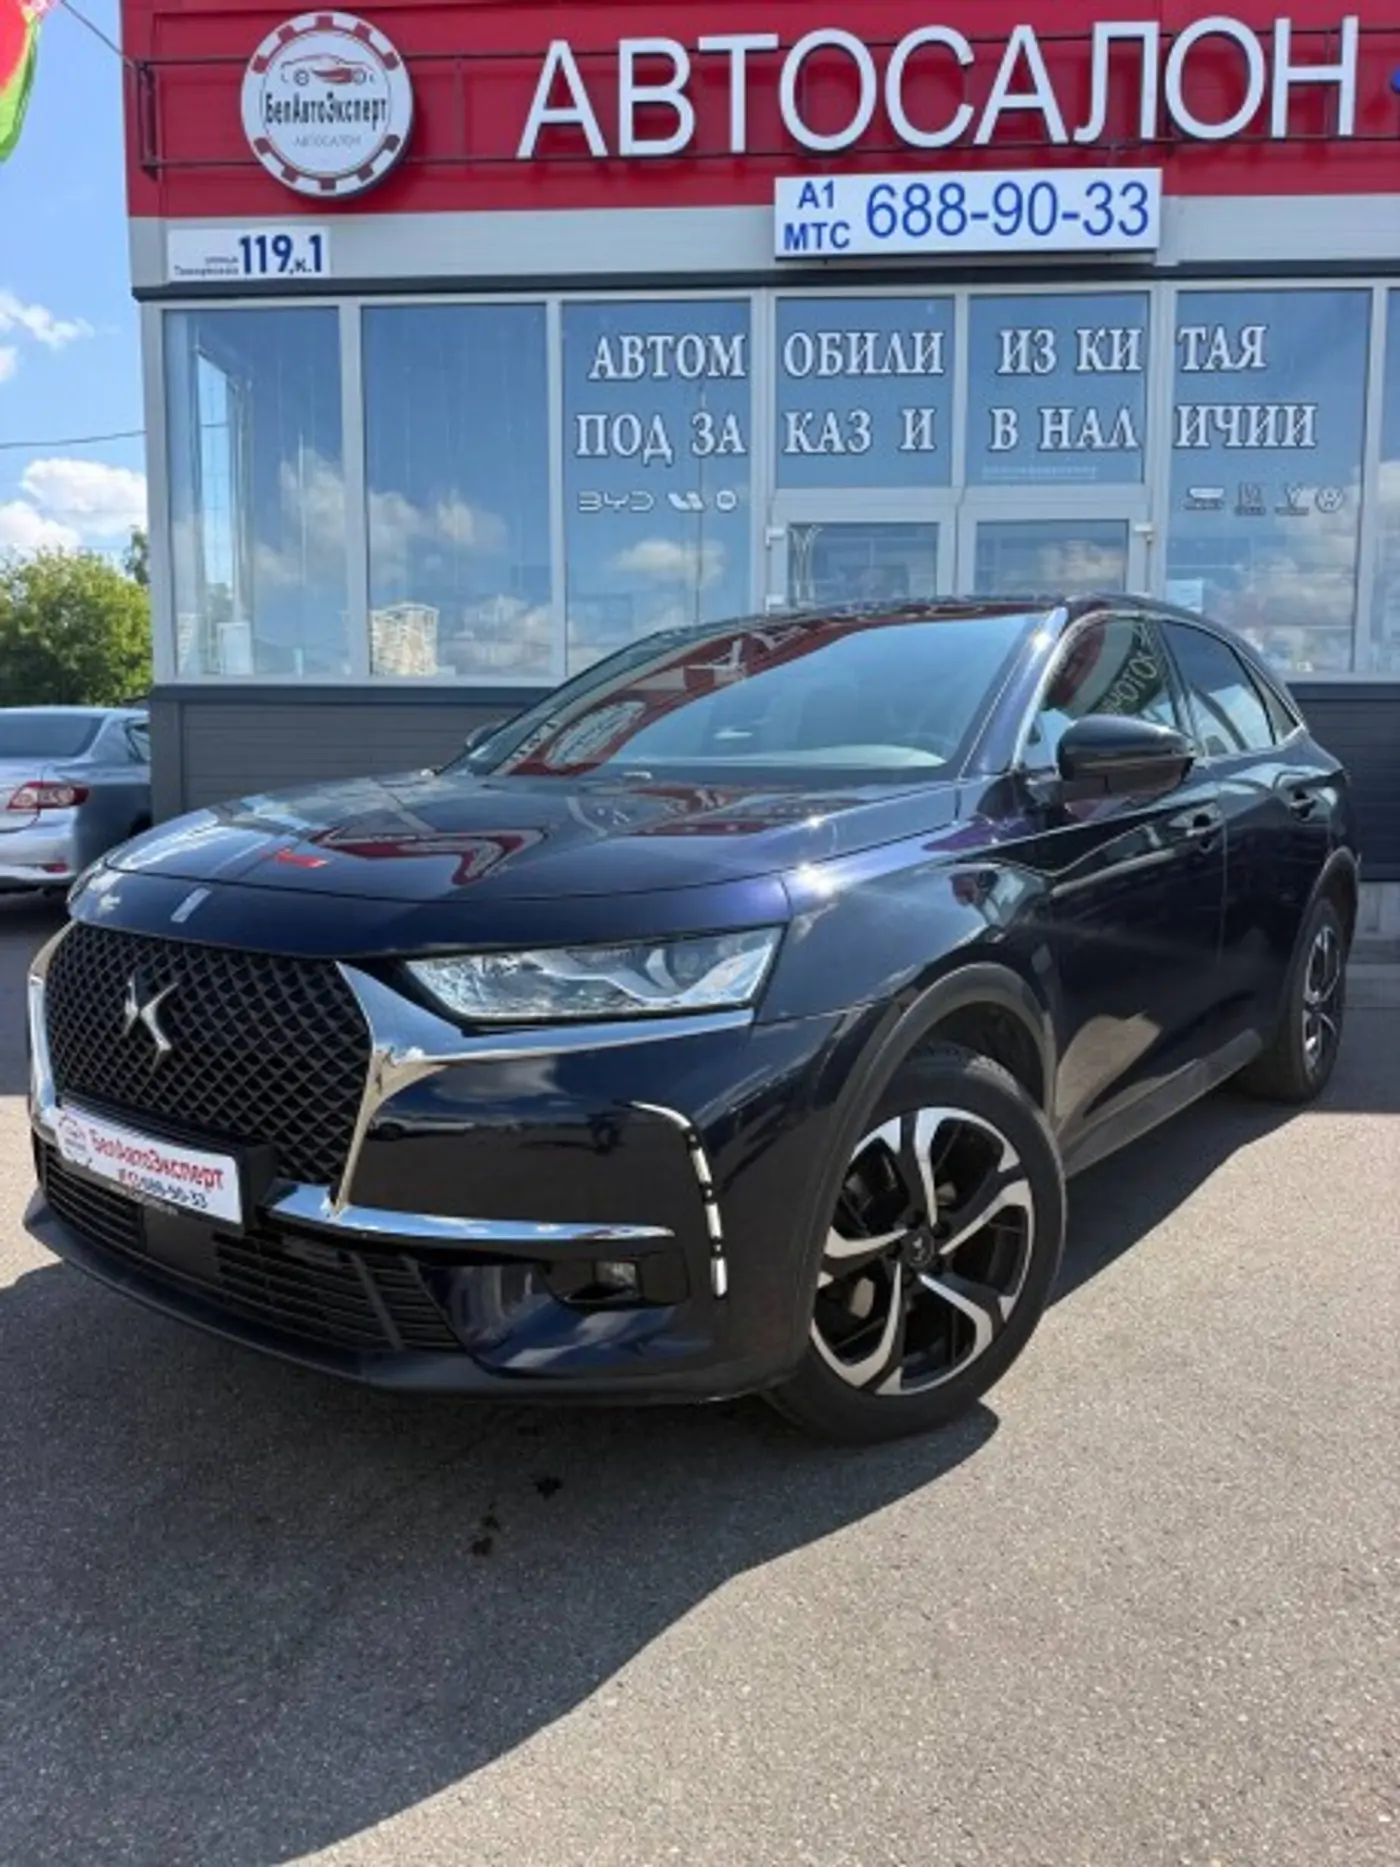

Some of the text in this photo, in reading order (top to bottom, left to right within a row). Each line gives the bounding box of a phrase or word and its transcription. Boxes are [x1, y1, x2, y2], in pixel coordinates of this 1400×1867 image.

[515, 16, 1359, 158] АВТОСАЛОН
[798, 181, 835, 209] А1
[866, 181, 1150, 238] 688-90-33
[783, 222, 850, 251] МТС
[997, 329, 1057, 374] ИЗ
[575, 413, 674, 466] ПОД
[900, 408, 936, 452] И
[989, 407, 1018, 452] В
